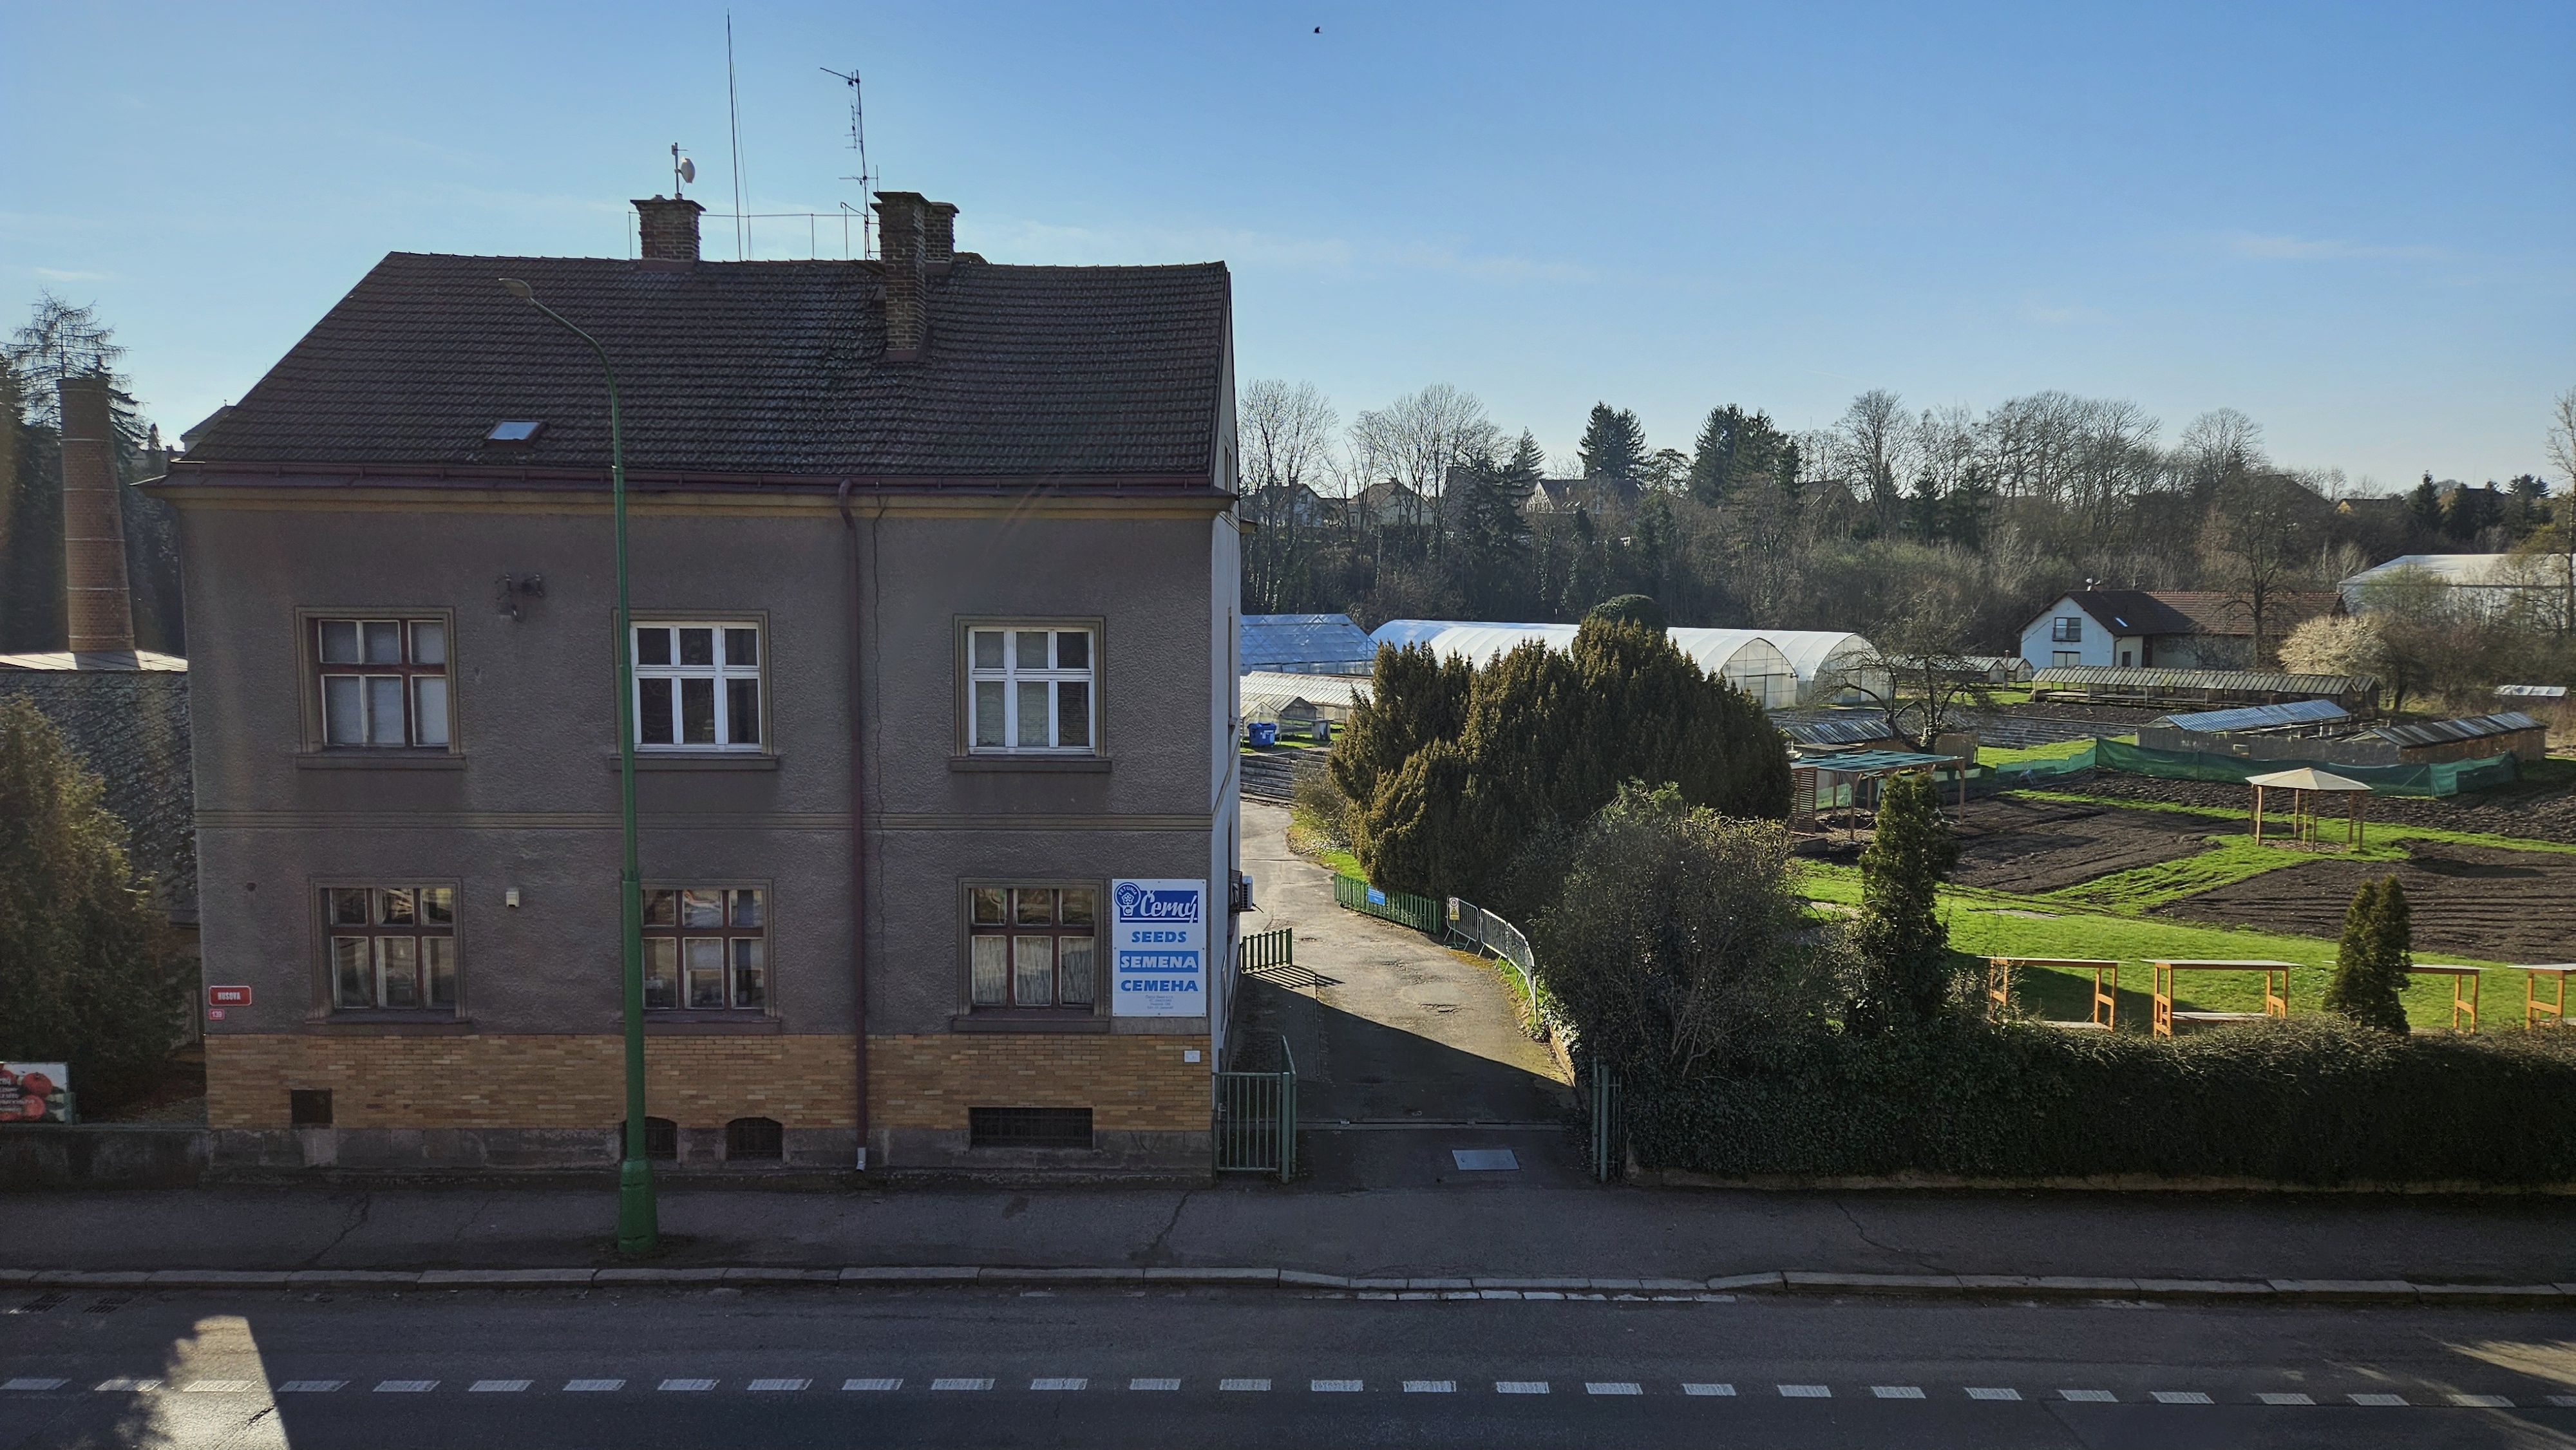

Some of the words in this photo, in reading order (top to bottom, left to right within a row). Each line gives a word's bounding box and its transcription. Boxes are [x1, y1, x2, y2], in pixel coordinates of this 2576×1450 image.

[1118, 885, 1138, 896] PETUNIA
[1140, 890, 1198, 923] Černý
[1132, 931, 1186, 943] SEEDS
[1121, 956, 1197, 968] SEMENA
[218, 992, 241, 1000] HUSOVA
